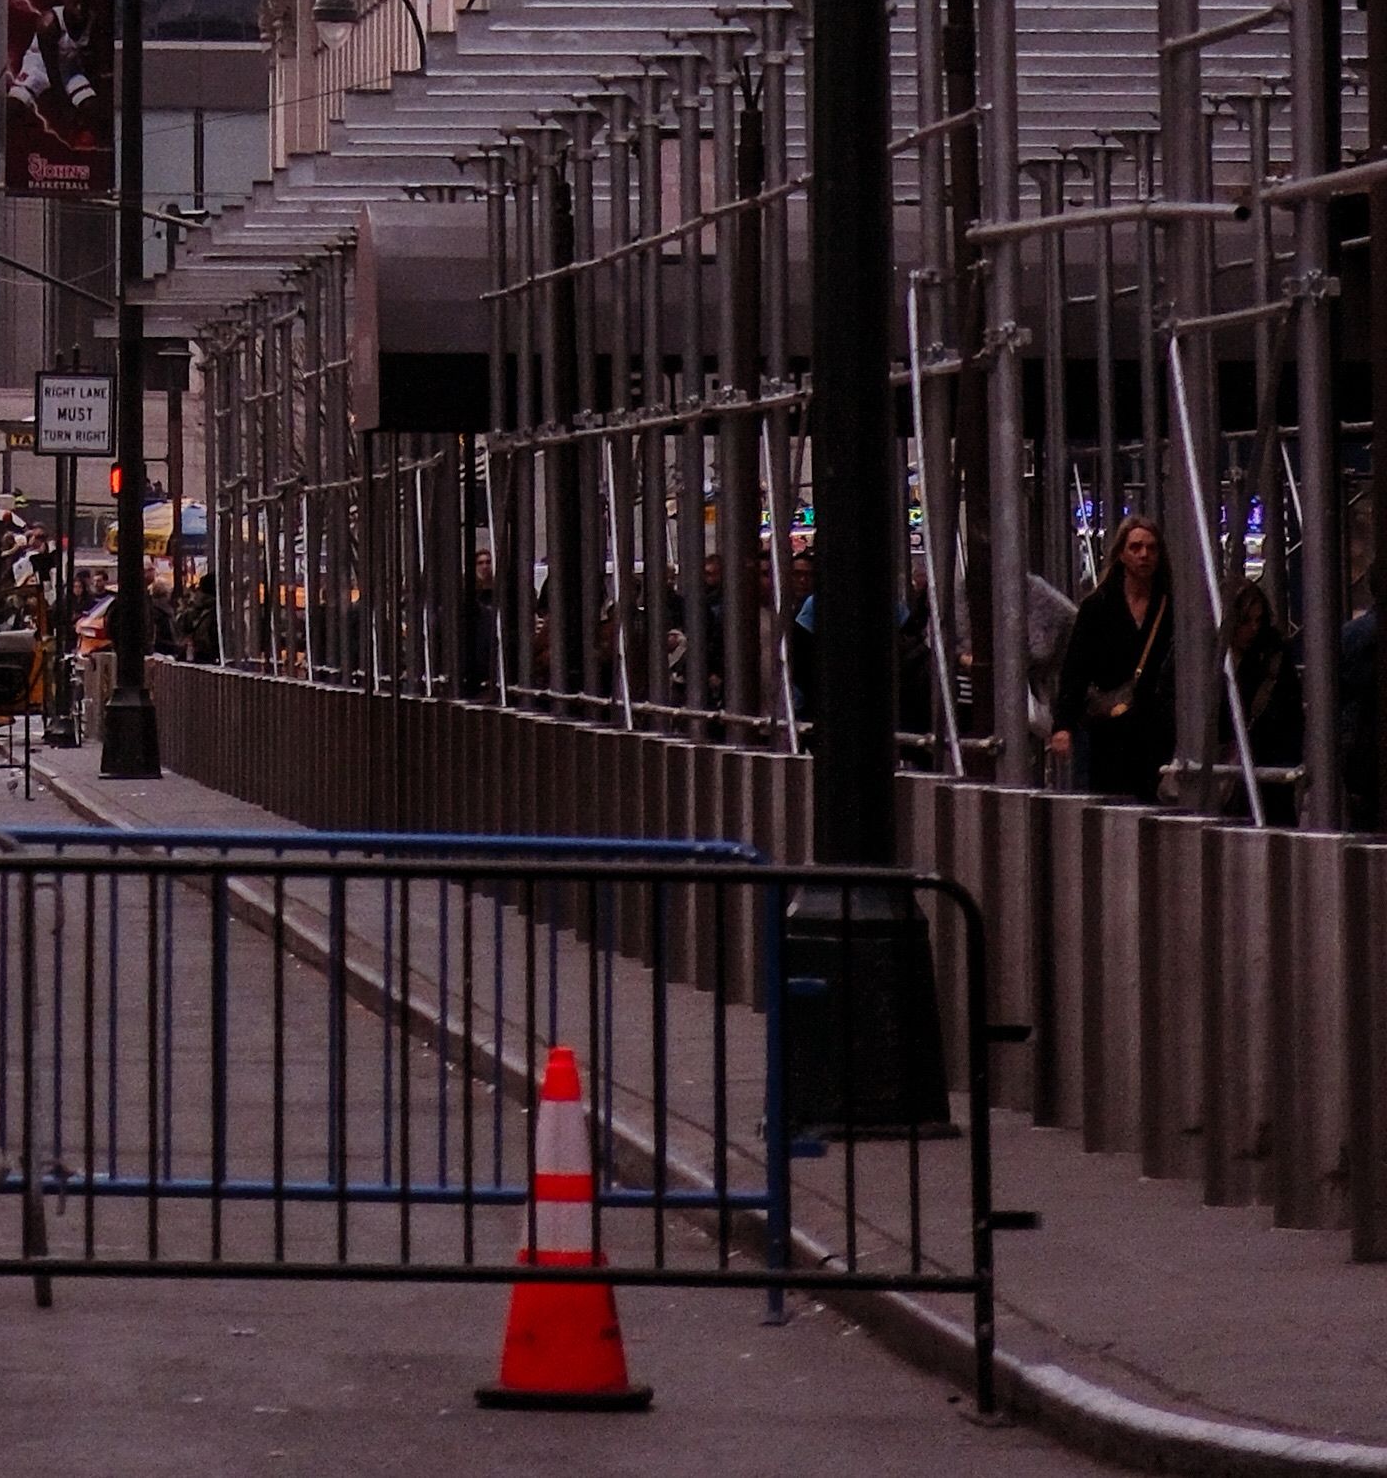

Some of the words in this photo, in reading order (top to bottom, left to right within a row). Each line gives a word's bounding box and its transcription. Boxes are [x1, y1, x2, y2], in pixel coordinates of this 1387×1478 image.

[28, 180, 90, 192] BASKETBALL
[43, 386, 76, 398] RIGHT
[80, 387, 108, 400] LANE
[57, 407, 93, 422] MUST
[43, 428, 72, 442] TURN
[75, 429, 107, 443] RIGHT
